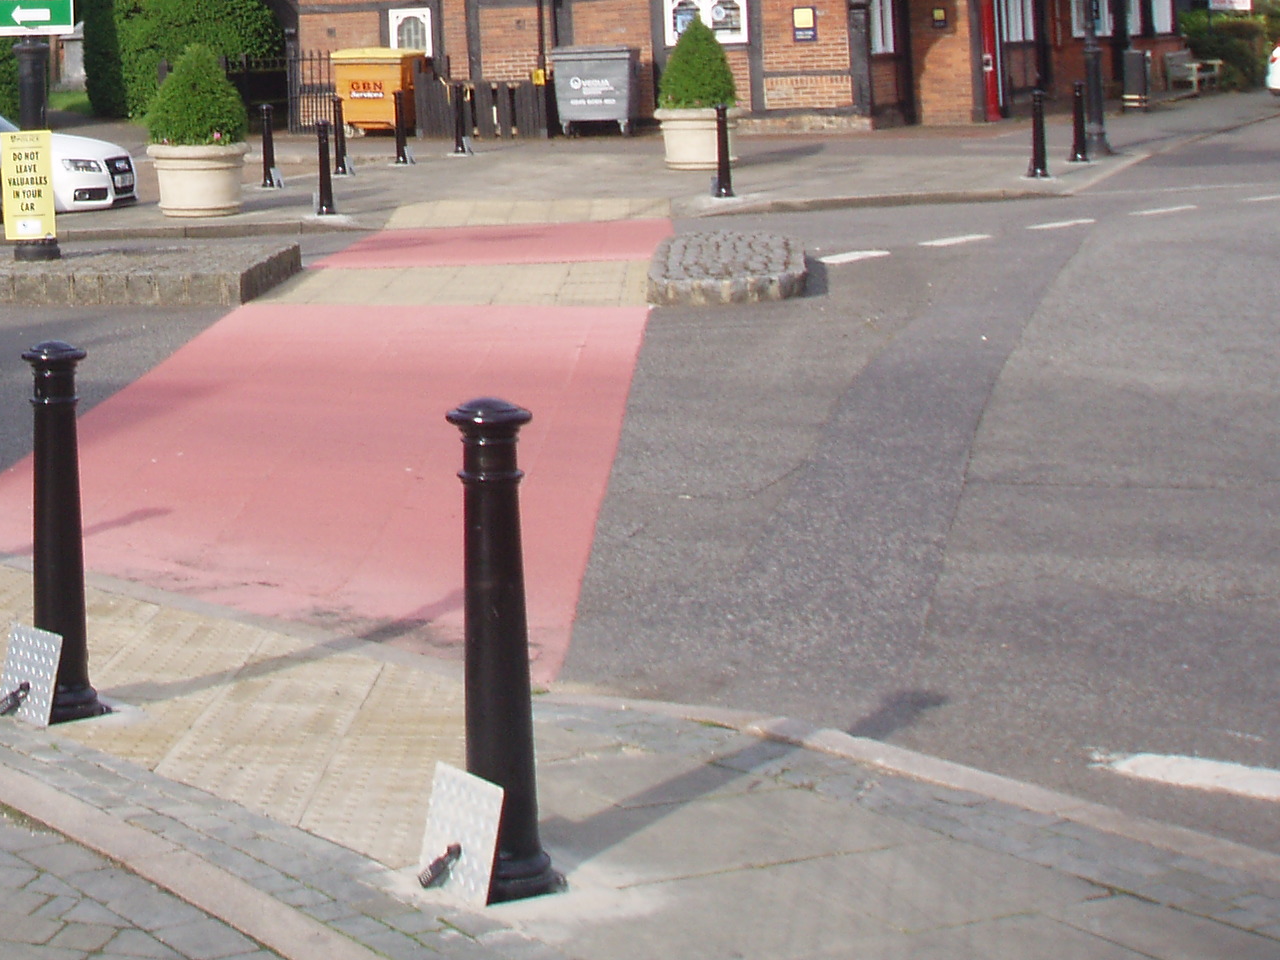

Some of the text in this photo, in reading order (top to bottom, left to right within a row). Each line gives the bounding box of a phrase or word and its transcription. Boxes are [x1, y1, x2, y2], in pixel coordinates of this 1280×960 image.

[350, 81, 383, 91] GBN
[12, 151, 39, 161] DO NOT
[16, 164, 37, 174] LEAVE
[7, 176, 48, 187] VALUABLES
[13, 189, 43, 199] IN YOUR
[20, 202, 35, 212] CAR
